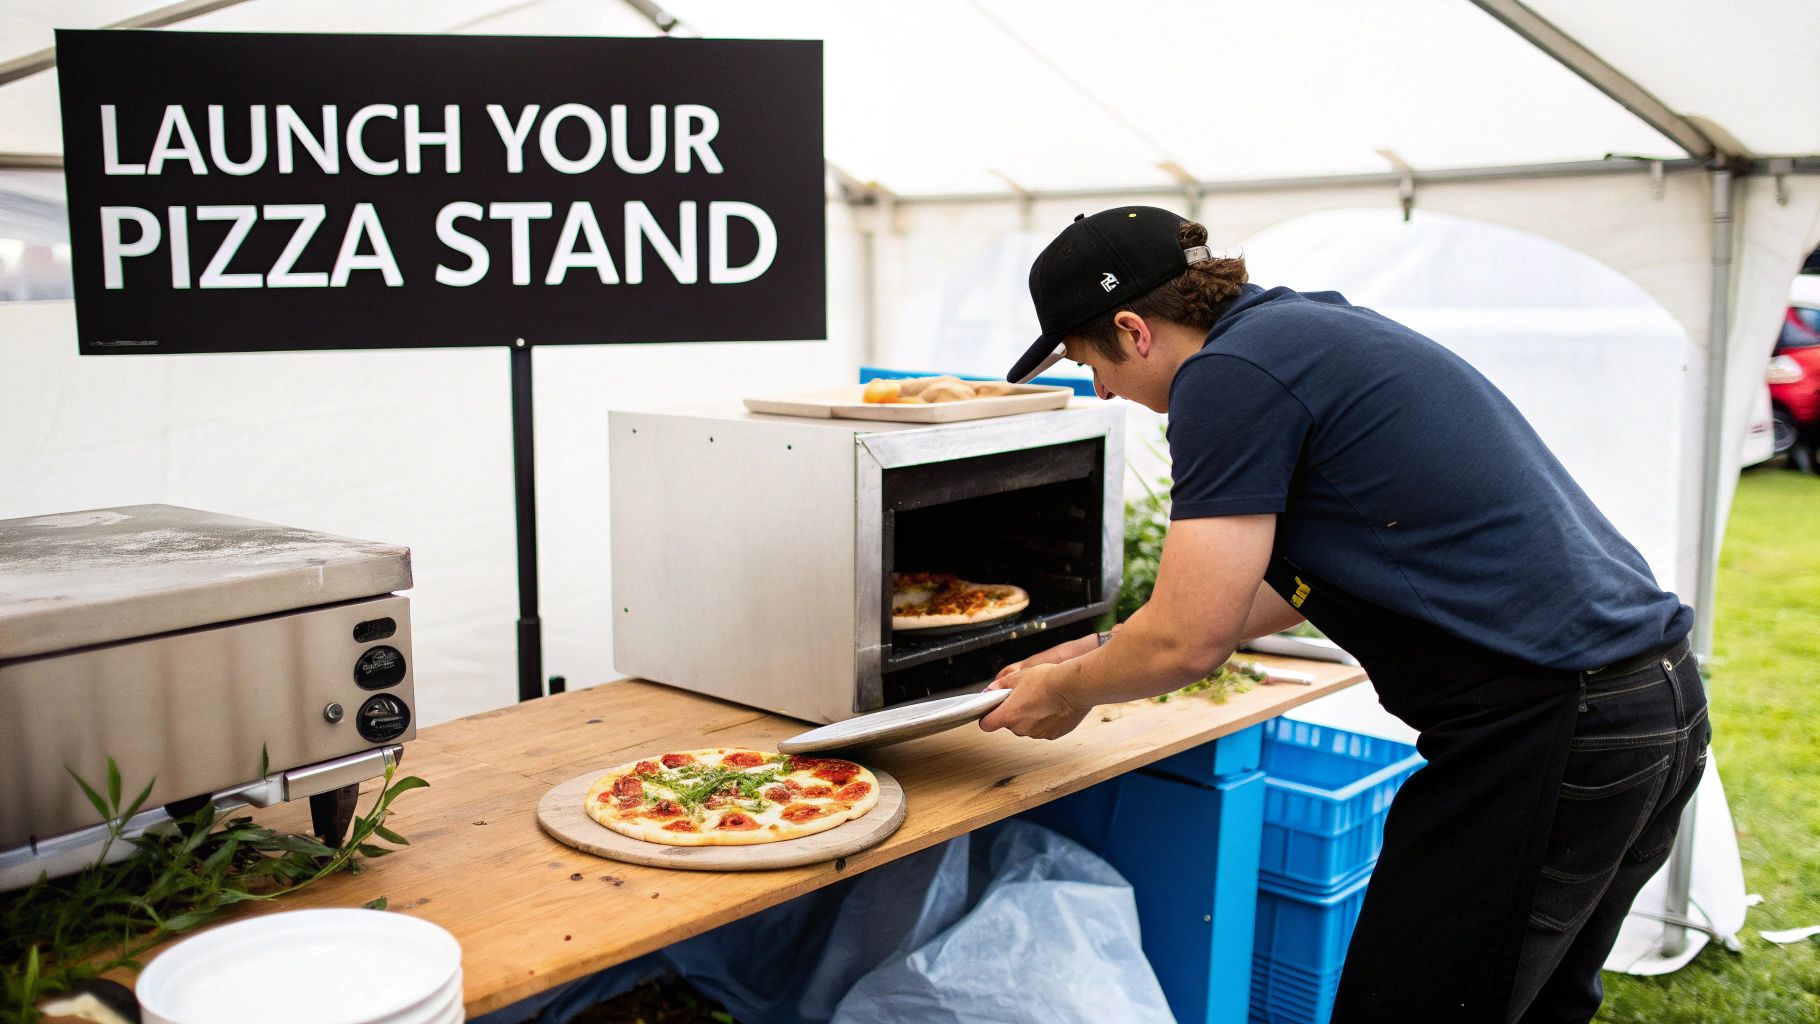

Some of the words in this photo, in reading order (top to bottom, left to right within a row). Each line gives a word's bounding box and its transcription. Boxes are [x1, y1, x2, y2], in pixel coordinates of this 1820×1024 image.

[101, 104, 461, 176] LAUNCH
[486, 103, 724, 175] YOUR
[101, 203, 404, 290] PIZZA
[436, 200, 778, 287] STAND
